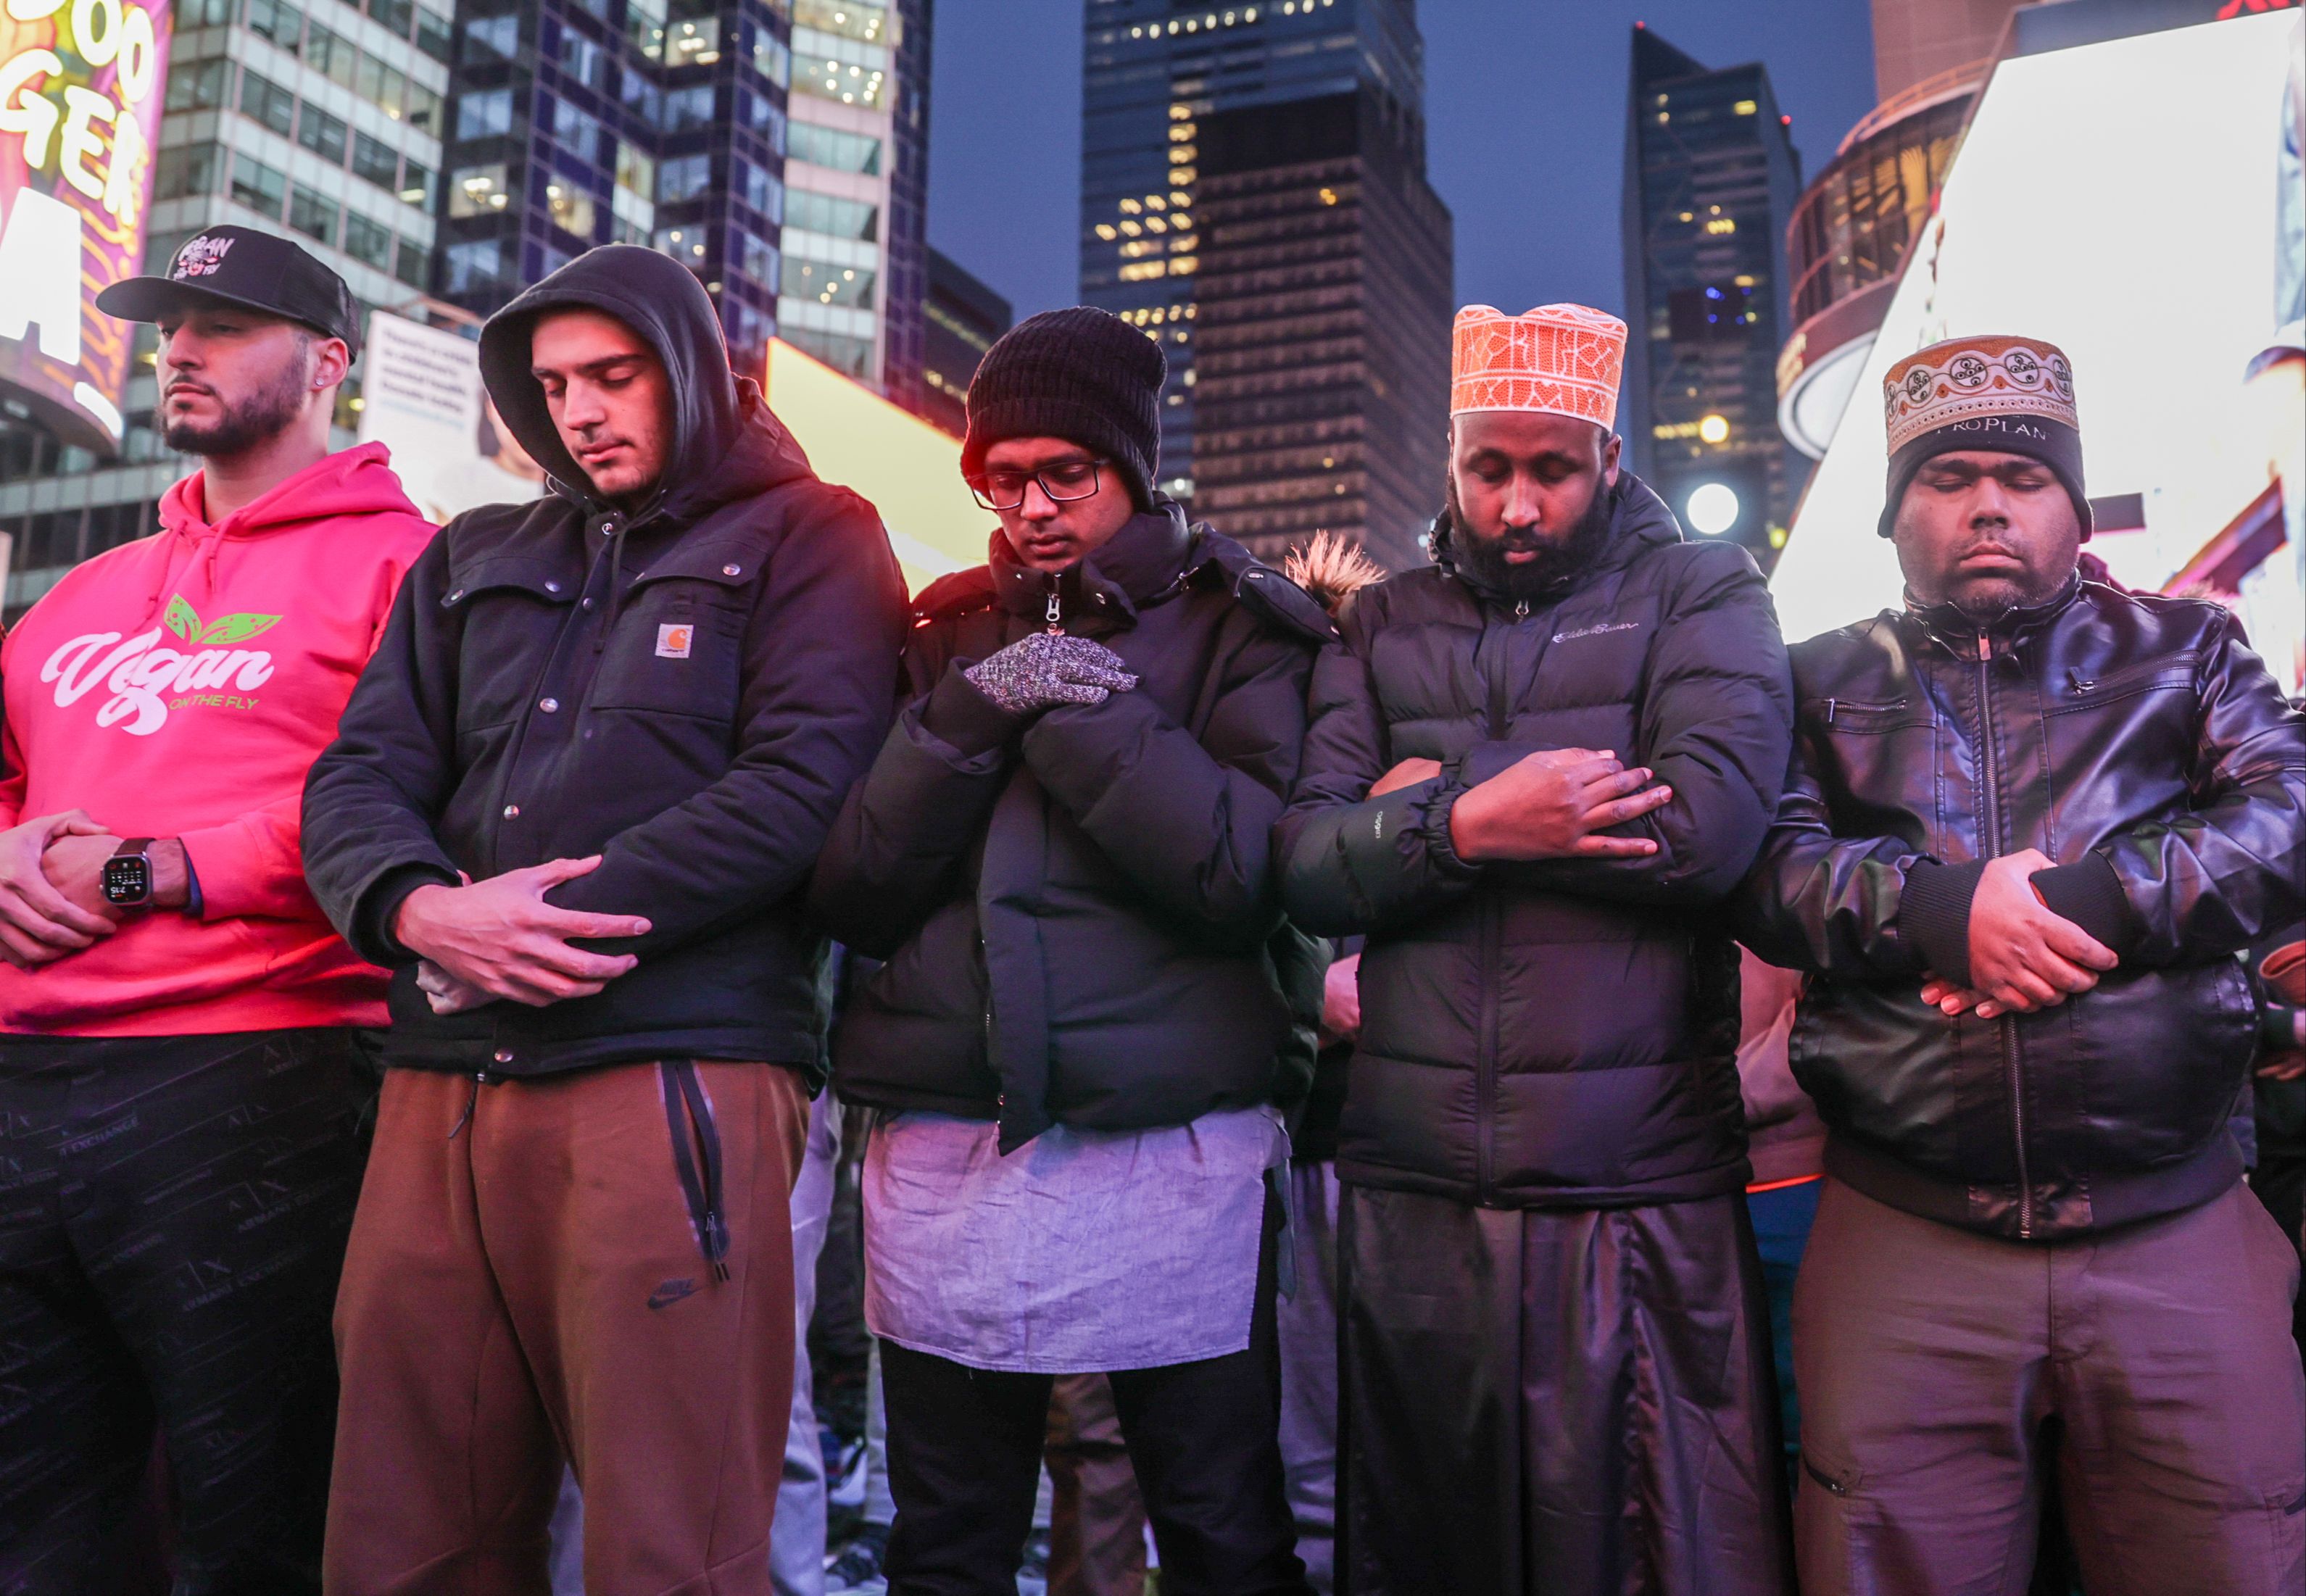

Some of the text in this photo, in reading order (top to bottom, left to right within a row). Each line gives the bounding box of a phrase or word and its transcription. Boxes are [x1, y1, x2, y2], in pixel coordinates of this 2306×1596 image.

[191, 694, 225, 707] THE
[225, 696, 260, 710] FLY
[71, 1115, 140, 1154] EXCHANGE
